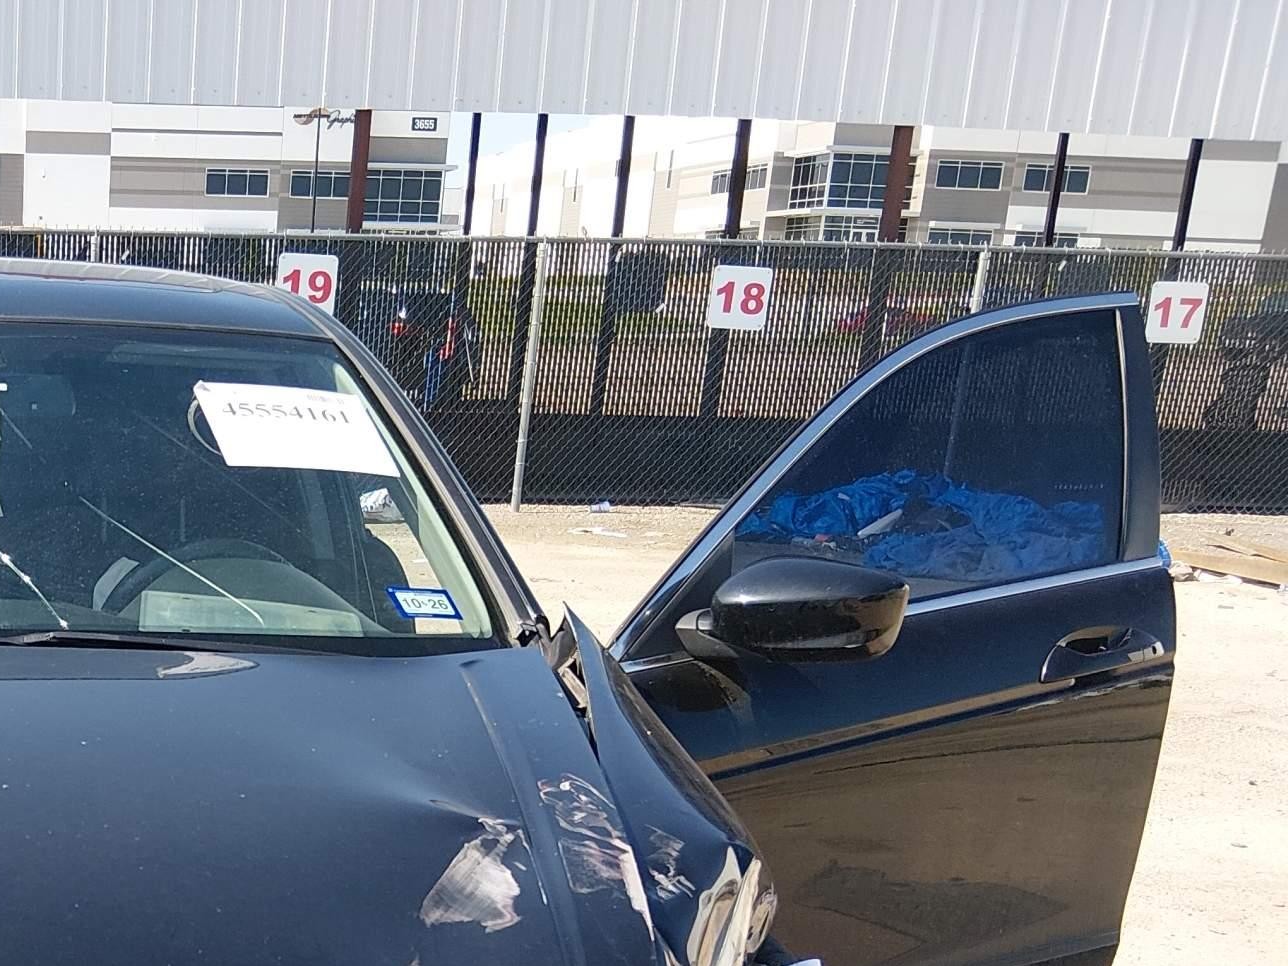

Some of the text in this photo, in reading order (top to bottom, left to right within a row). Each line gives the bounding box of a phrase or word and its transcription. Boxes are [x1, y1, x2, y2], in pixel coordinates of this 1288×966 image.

[414, 119, 435, 130] 3655
[282, 269, 332, 304] 19
[717, 281, 766, 315] 18
[1154, 296, 1203, 329] 17
[222, 402, 350, 424] 45554161
